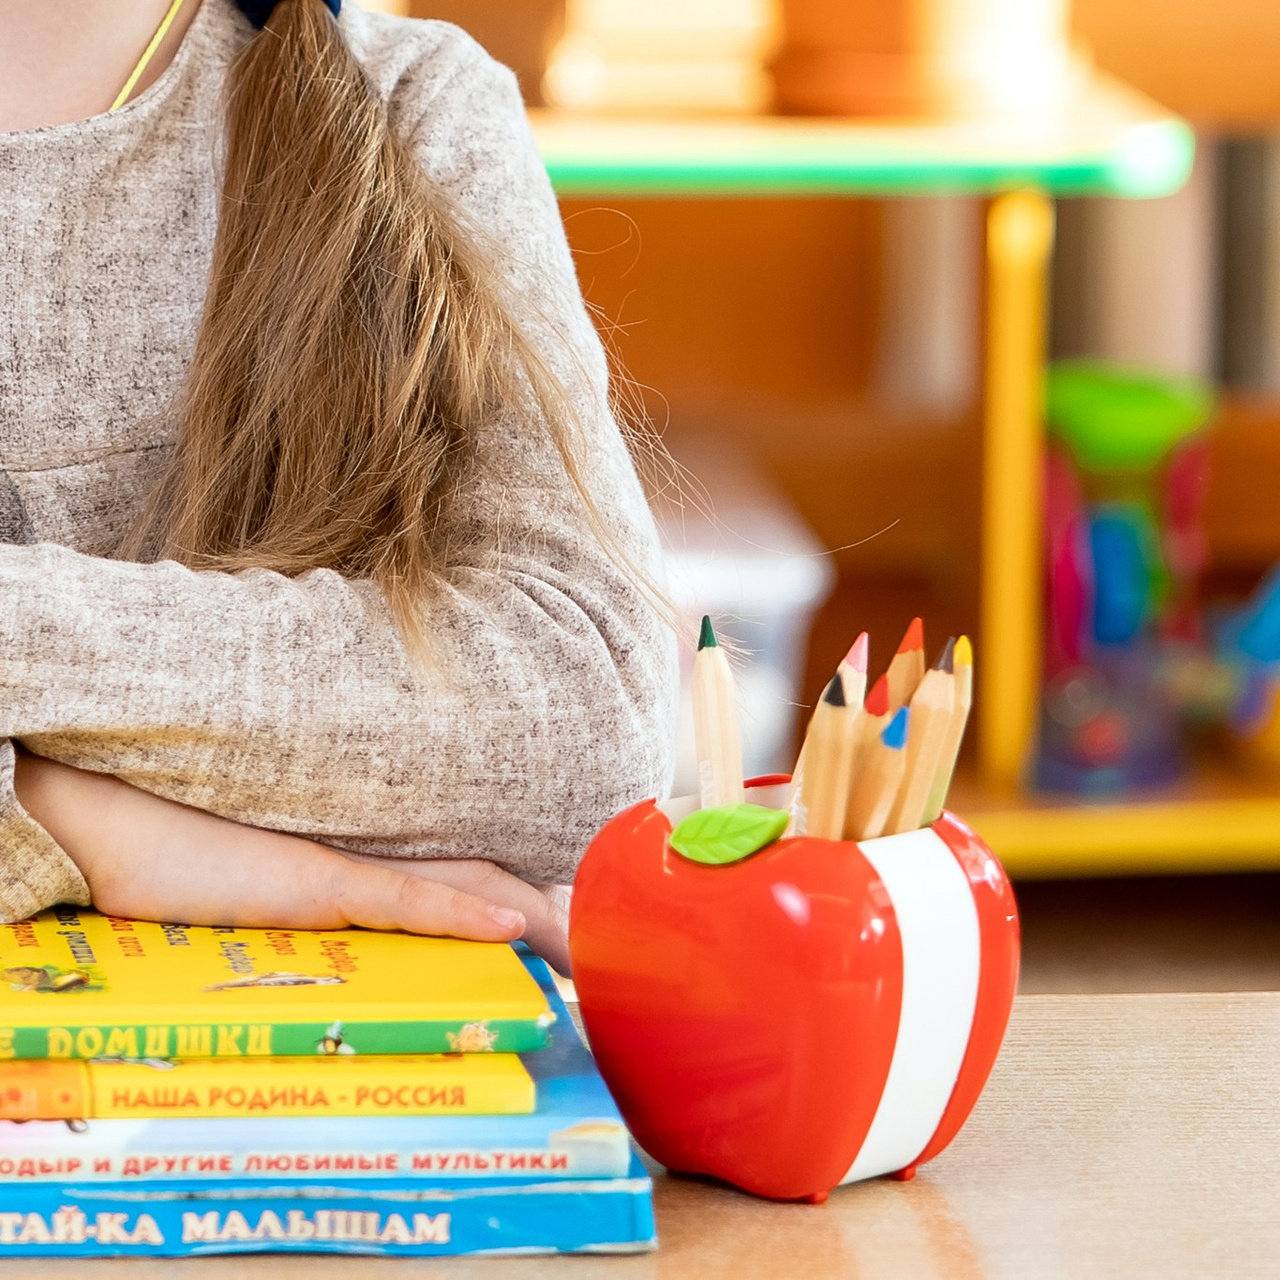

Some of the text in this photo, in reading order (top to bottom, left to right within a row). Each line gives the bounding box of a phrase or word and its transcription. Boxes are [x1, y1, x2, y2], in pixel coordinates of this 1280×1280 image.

[56, 931, 97, 964] домишки
[118, 936, 146, 958] охота
[218, 940, 258, 974] Медведь
[265, 931, 297, 955] Мороз
[320, 939, 360, 973] Медведь
[47, 1023, 273, 1059] ДОМИШКИ
[111, 1086, 200, 1108] НАША
[209, 1086, 329, 1111] РОДИНА
[356, 1086, 466, 1107] РОССИЯ
[93, 1158, 112, 1173] И
[122, 1155, 233, 1176] ДРУГИЕ
[243, 1153, 399, 1174] ЛЮБИМЫЕ
[411, 1152, 569, 1172] МУЛЬТИКИ
[181, 1209, 452, 1245] МАЛЫШАМ
